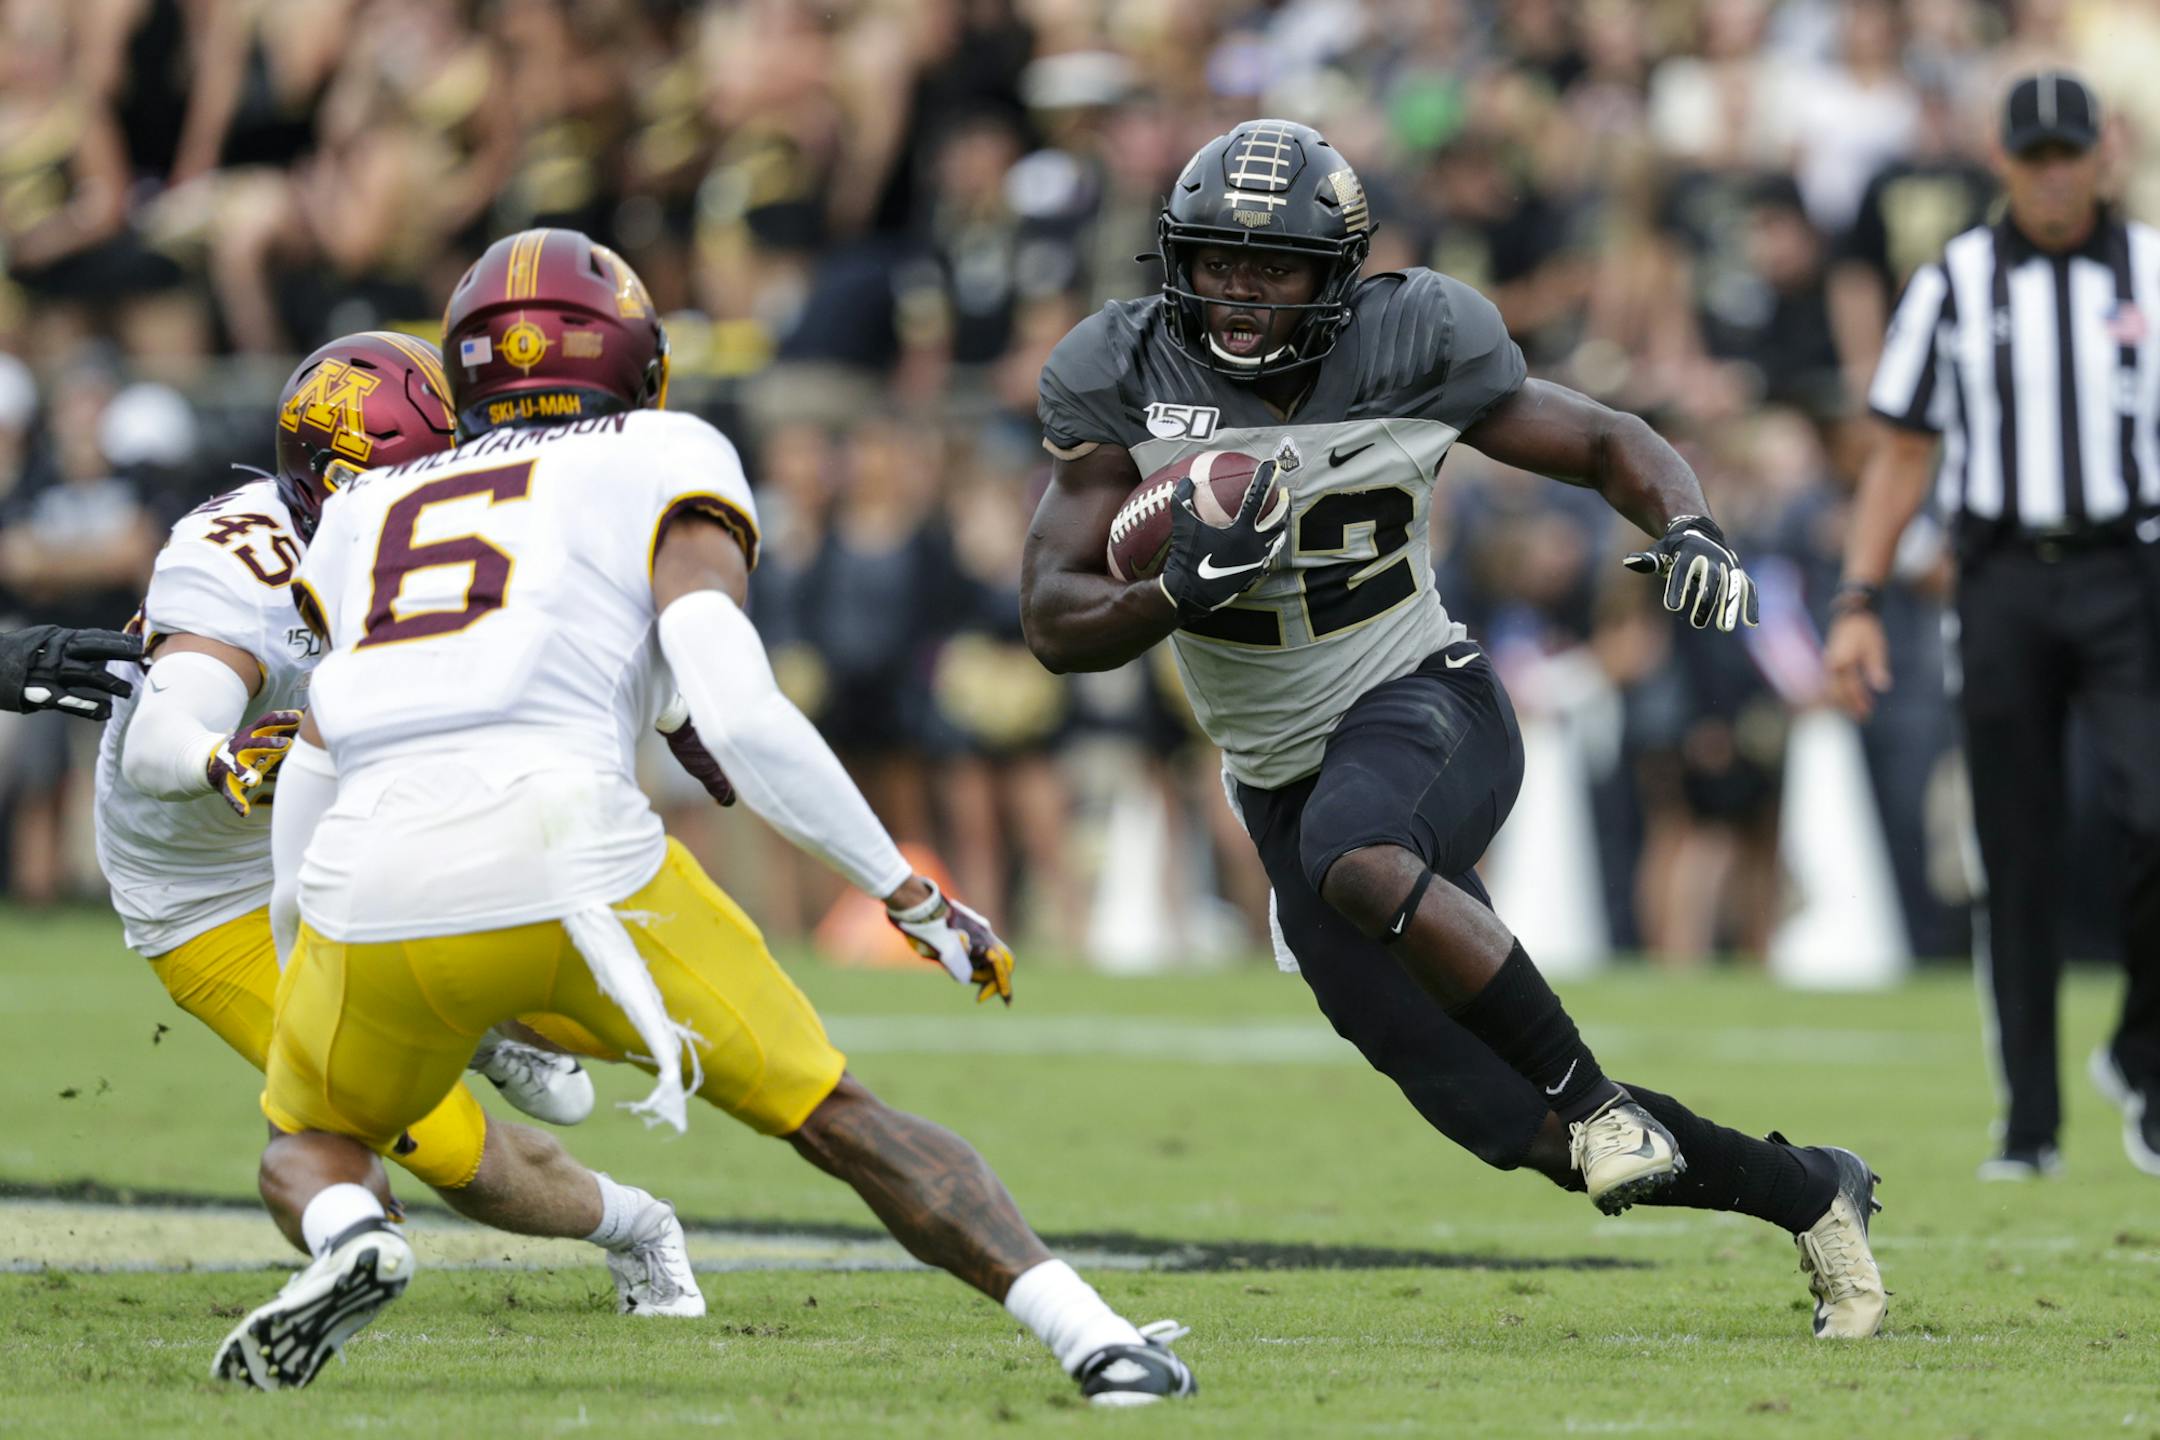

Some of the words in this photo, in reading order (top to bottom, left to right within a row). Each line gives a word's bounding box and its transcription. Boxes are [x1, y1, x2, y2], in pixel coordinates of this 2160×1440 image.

[280, 358, 381, 462] M
[489, 393, 581, 425] SKI-U-MAH
[1152, 405, 1217, 439] 150
[352, 457, 540, 653] 6
